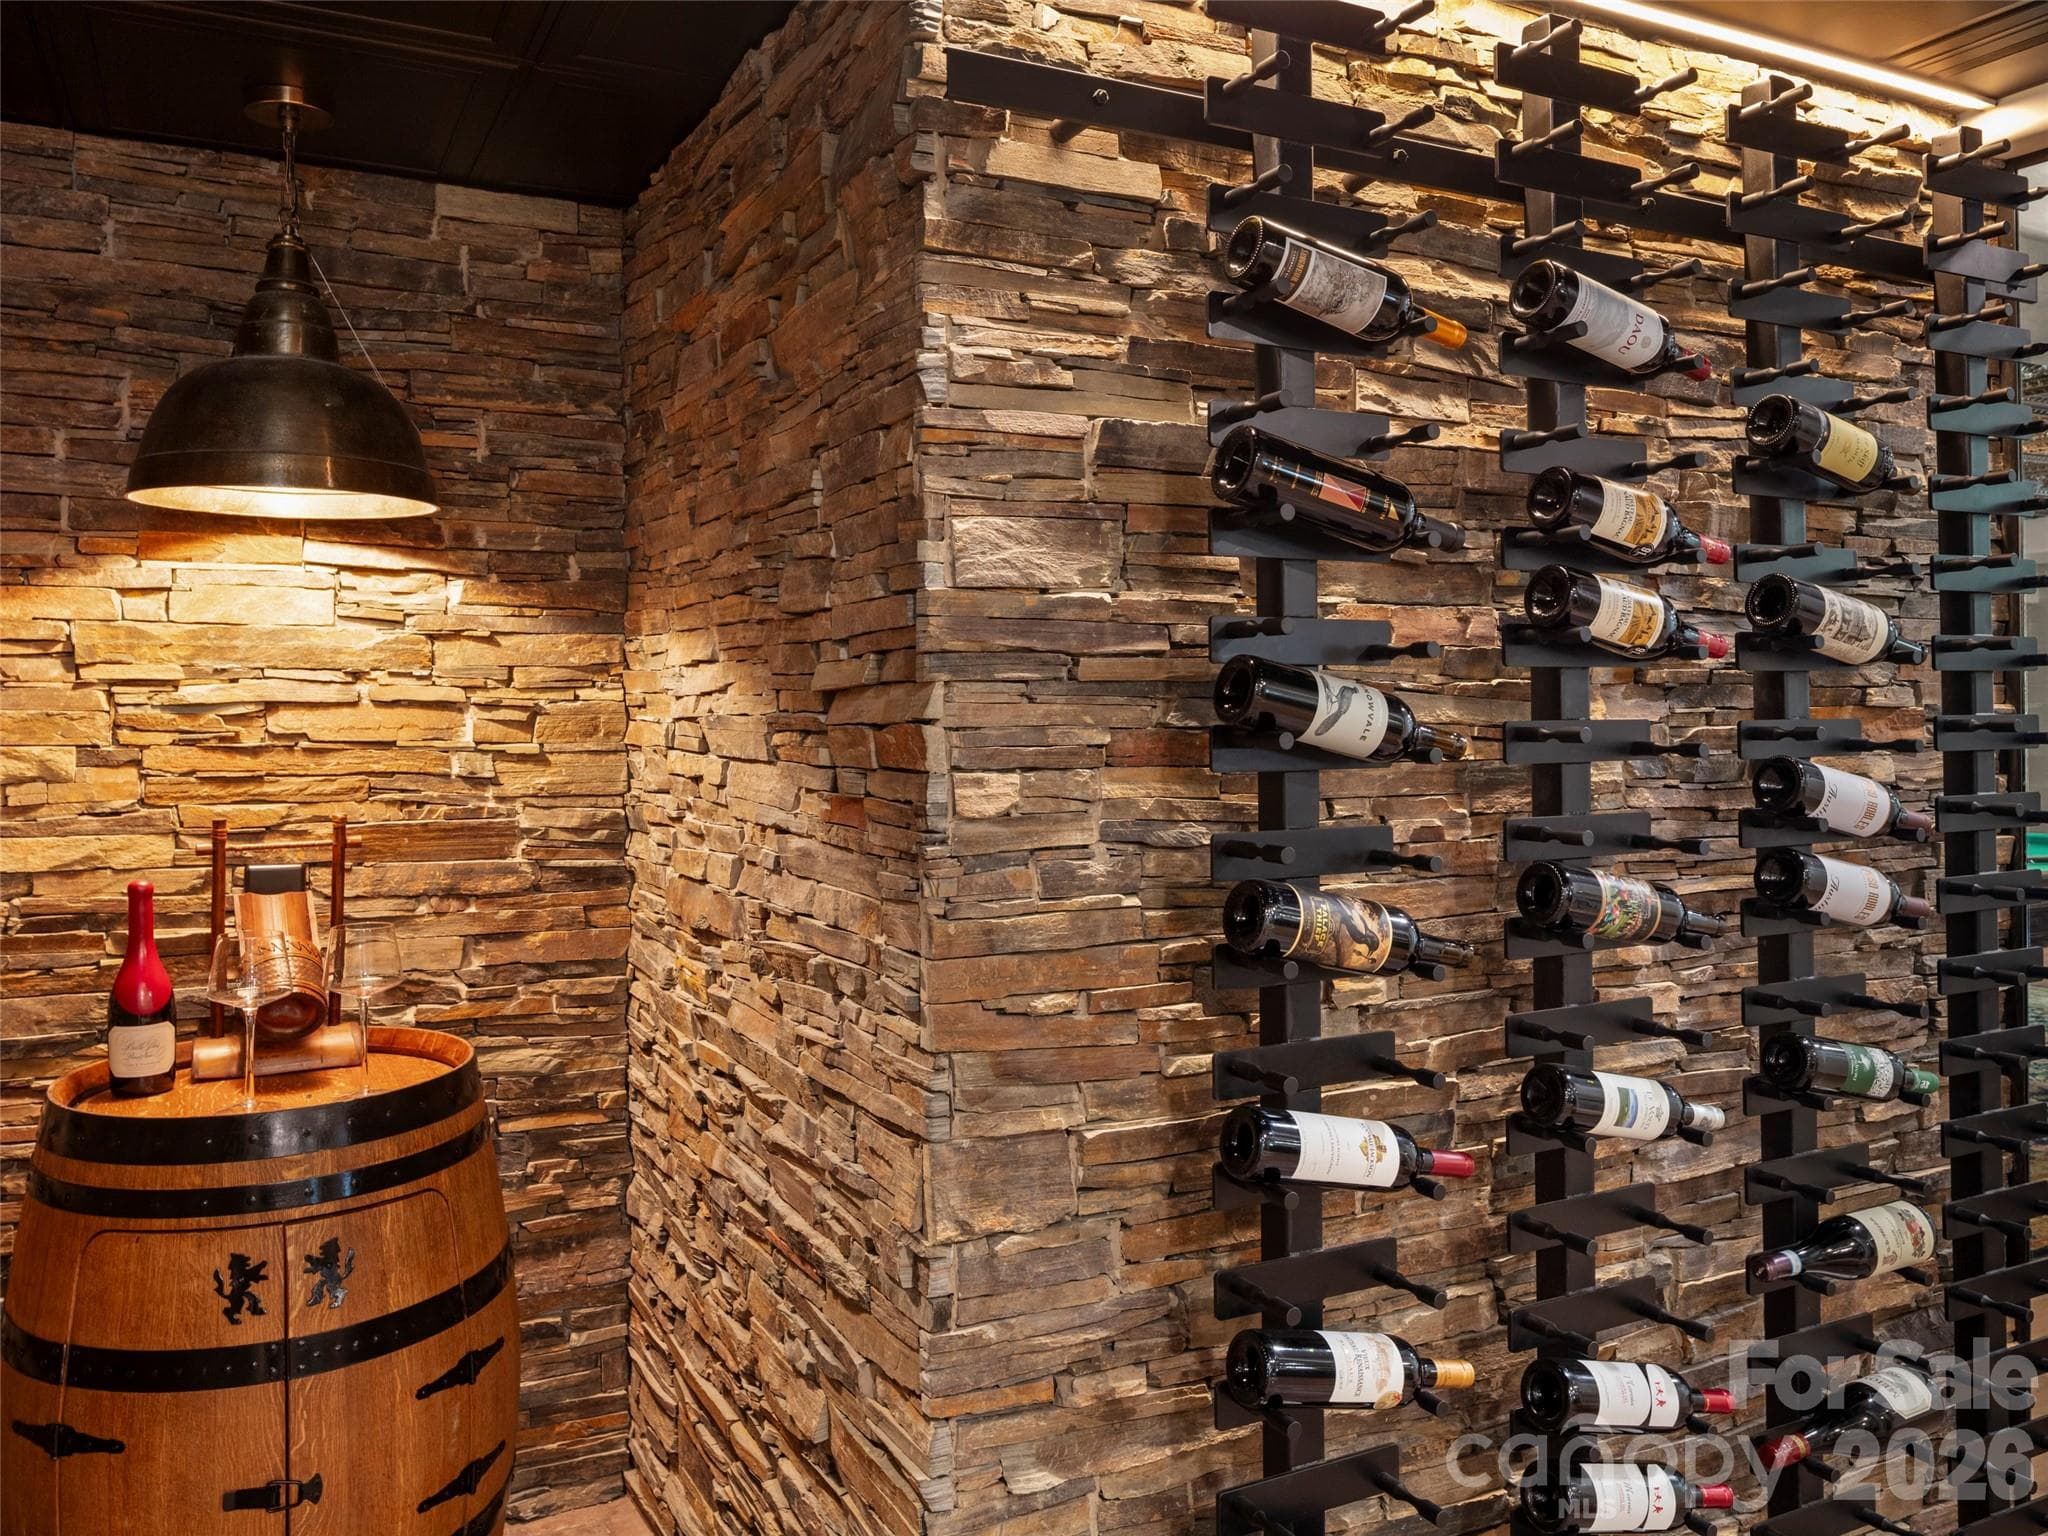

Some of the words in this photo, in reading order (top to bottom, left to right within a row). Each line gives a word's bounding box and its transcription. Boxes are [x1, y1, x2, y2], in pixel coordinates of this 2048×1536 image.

[1618, 313, 1645, 355] DAOU
[1854, 801, 1879, 831] ROBLES
[1854, 892, 1879, 920] ROBLES
[1313, 907, 1323, 942] THIEF
[1317, 903, 1329, 948] PALACE
